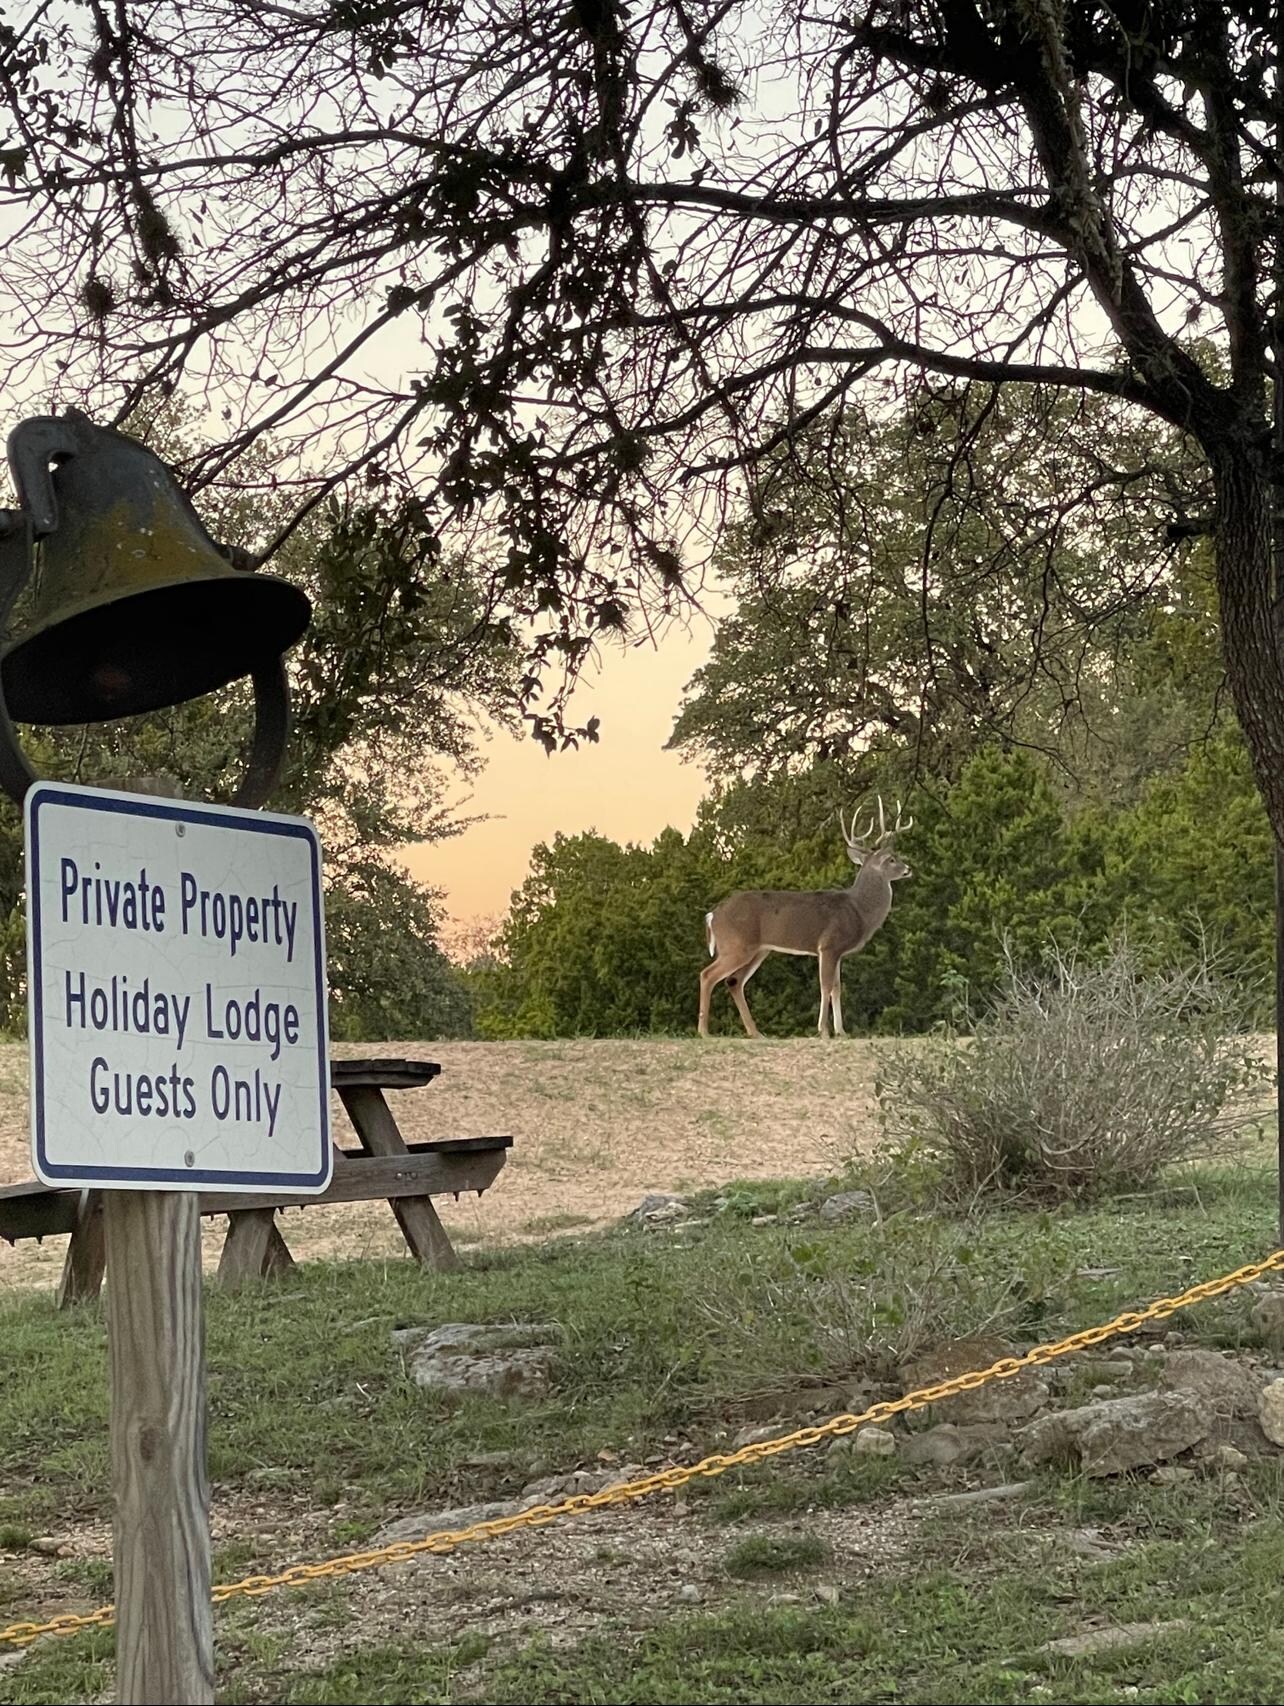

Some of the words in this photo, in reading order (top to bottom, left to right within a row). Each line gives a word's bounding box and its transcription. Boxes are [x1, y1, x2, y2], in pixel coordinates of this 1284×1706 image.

[60, 857, 165, 933] Private
[180, 871, 297, 962] Property
[65, 970, 190, 1050] Holiday
[205, 983, 299, 1061] Lodge
[90, 1056, 197, 1119] Guests
[211, 1064, 282, 1137] Only
